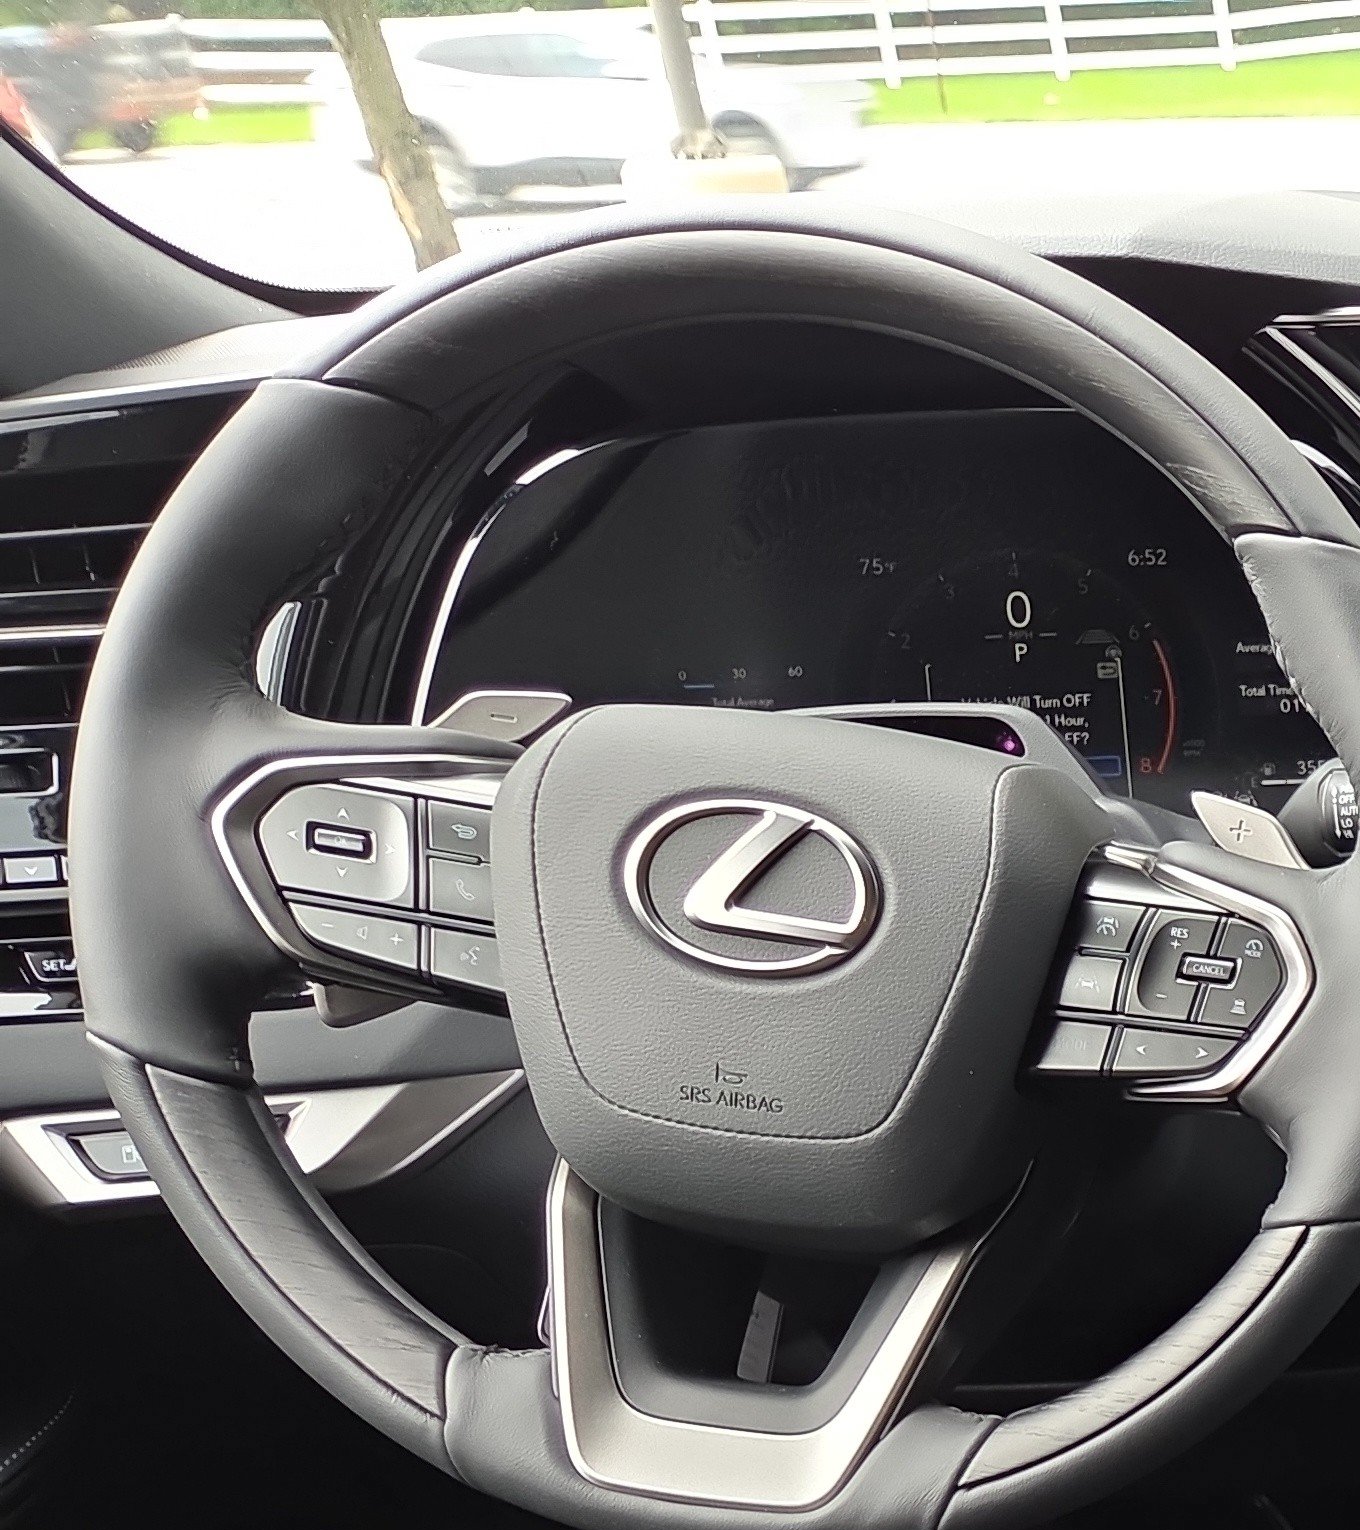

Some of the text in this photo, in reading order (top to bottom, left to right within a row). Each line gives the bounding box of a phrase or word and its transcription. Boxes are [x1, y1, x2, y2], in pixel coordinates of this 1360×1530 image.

[1127, 549, 1167, 566] 6:52
[1006, 590, 1032, 628] 0
[1014, 643, 1028, 663] P
[731, 668, 747, 679] 30
[788, 666, 803, 677] 60
[1033, 695, 1061, 708] Turn
[1063, 693, 1092, 708] OFF
[1054, 713, 1089, 728] Hour,
[1170, 927, 1189, 939] RES
[42, 958, 66, 972] SET
[1193, 963, 1226, 976] CANCEL
[680, 1085, 784, 1113] SRS AIRBAG
